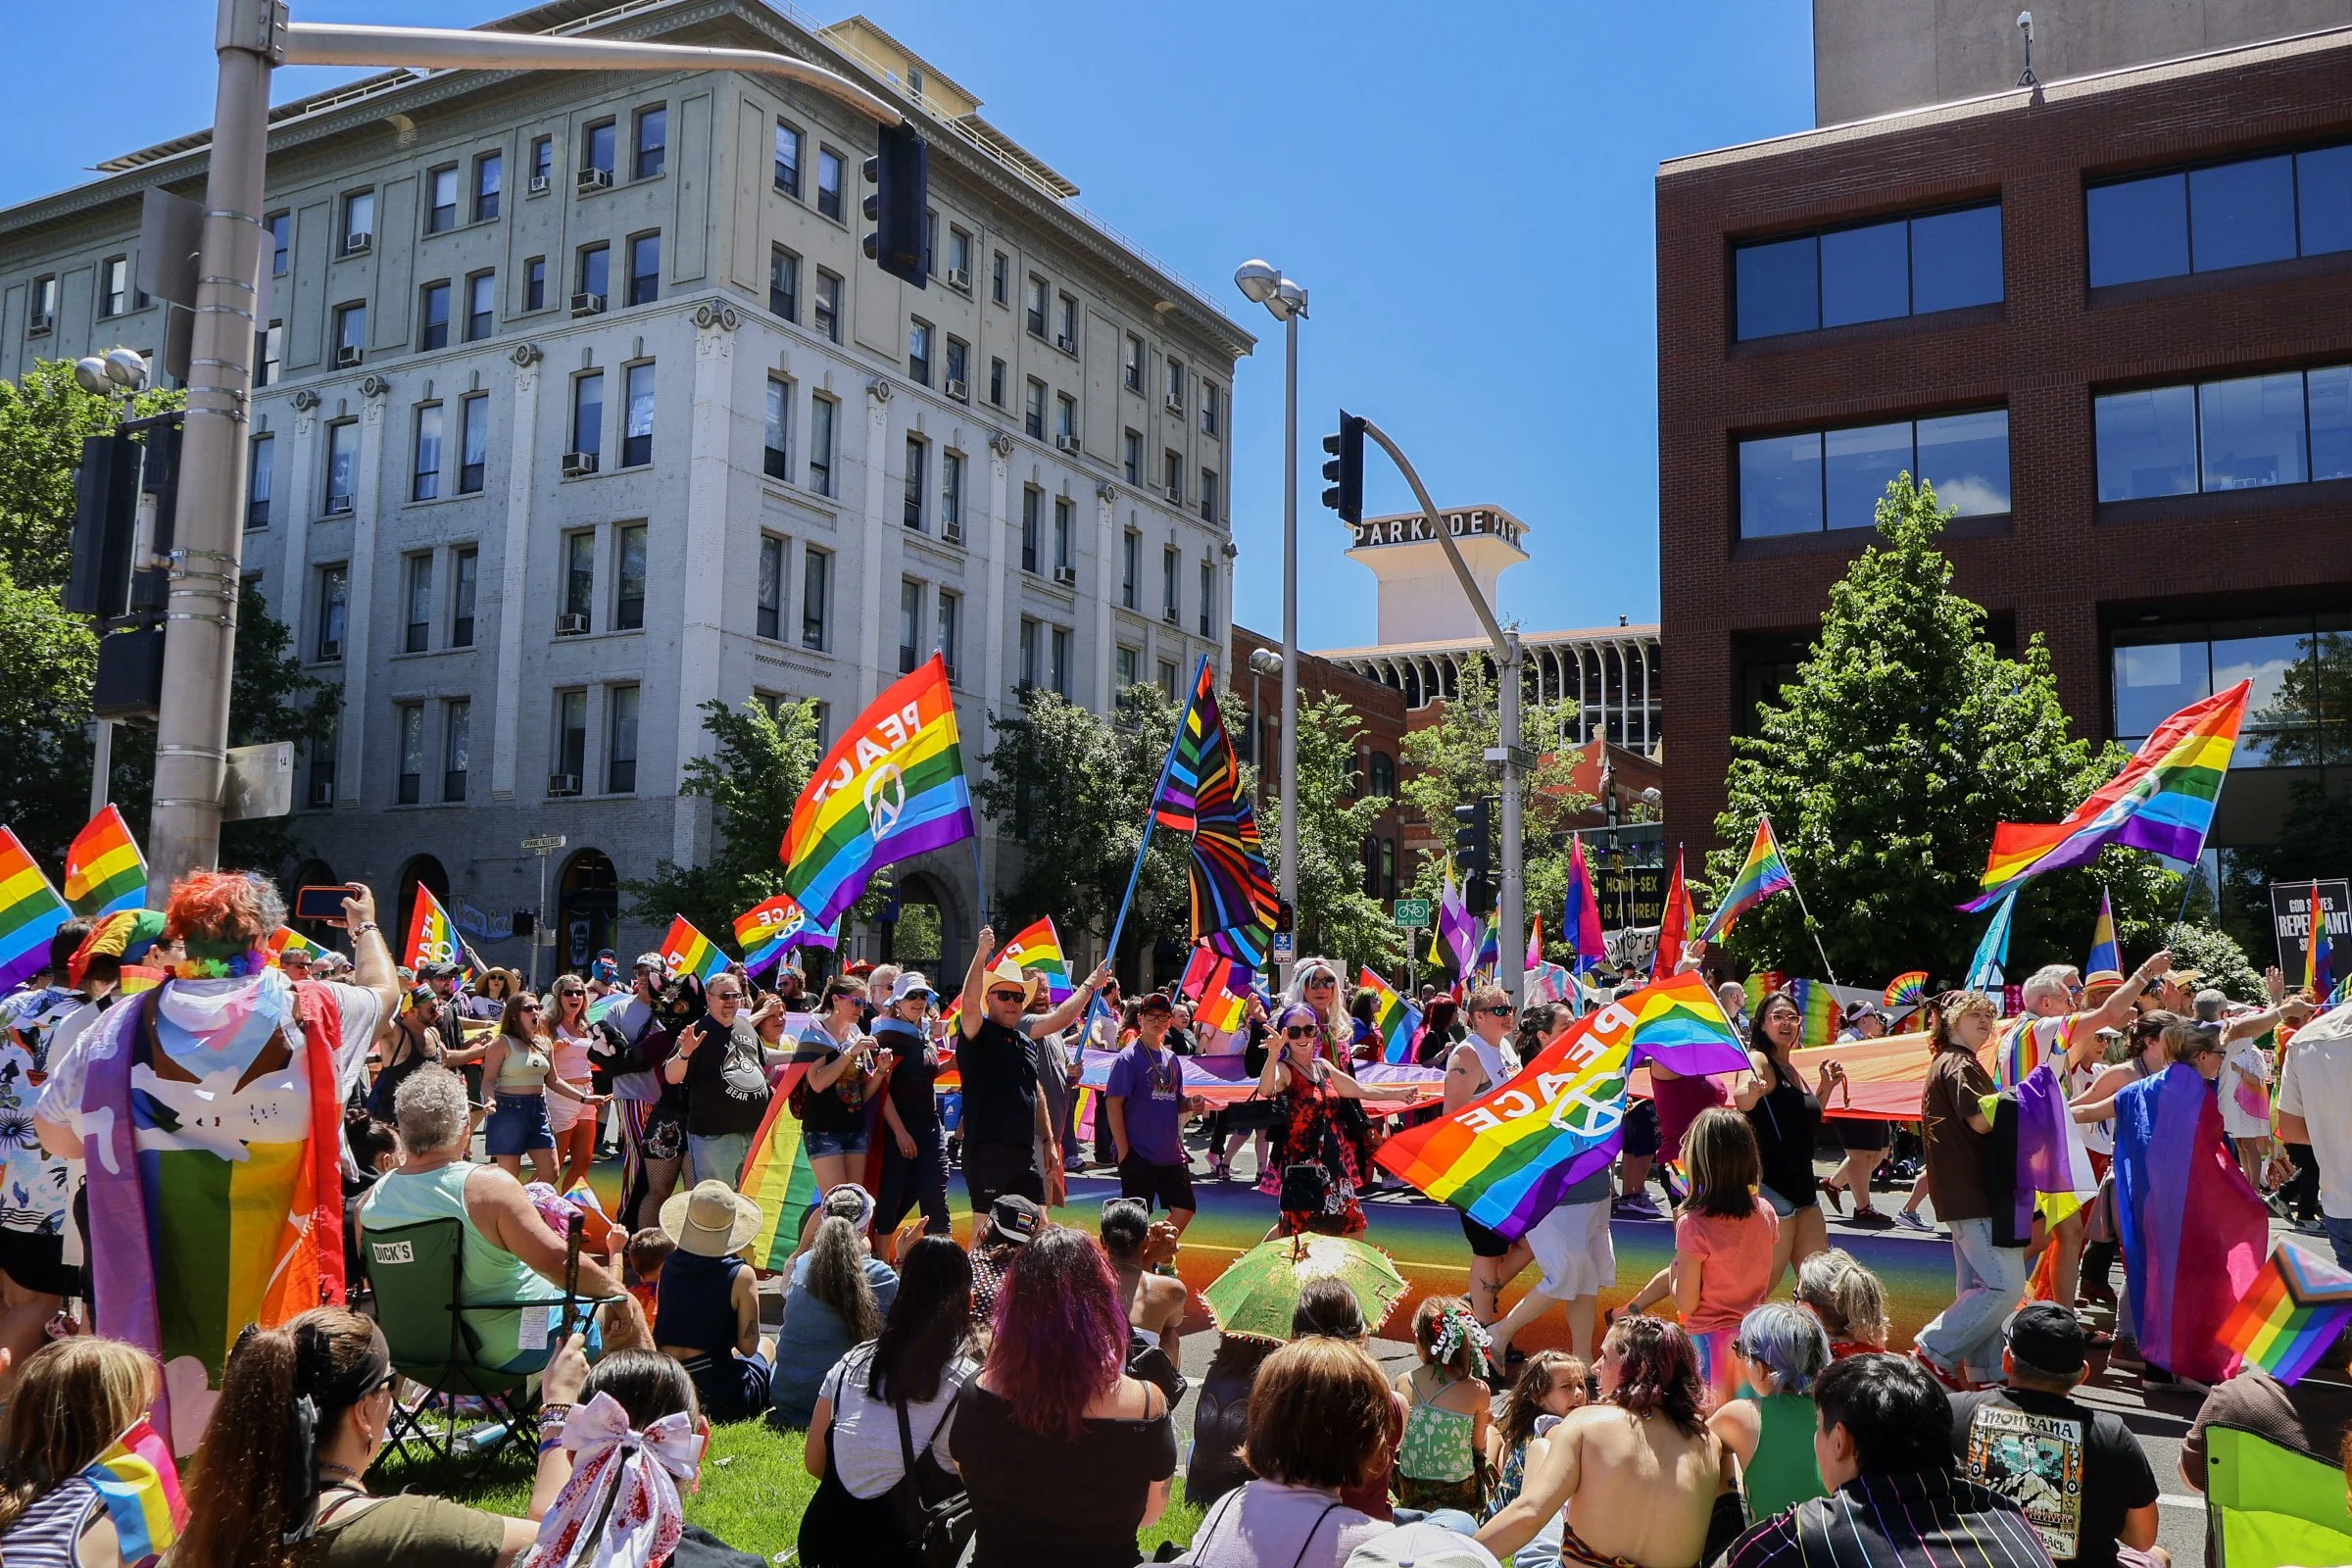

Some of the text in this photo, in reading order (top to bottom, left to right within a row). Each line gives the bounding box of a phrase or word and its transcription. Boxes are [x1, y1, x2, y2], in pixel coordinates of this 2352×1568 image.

[1603, 903, 1660, 919] IS A THREAT
[2288, 897, 2333, 912] GOD SVES
[2278, 911, 2348, 937] REPEANT
[725, 1086, 749, 1102] BEAR
